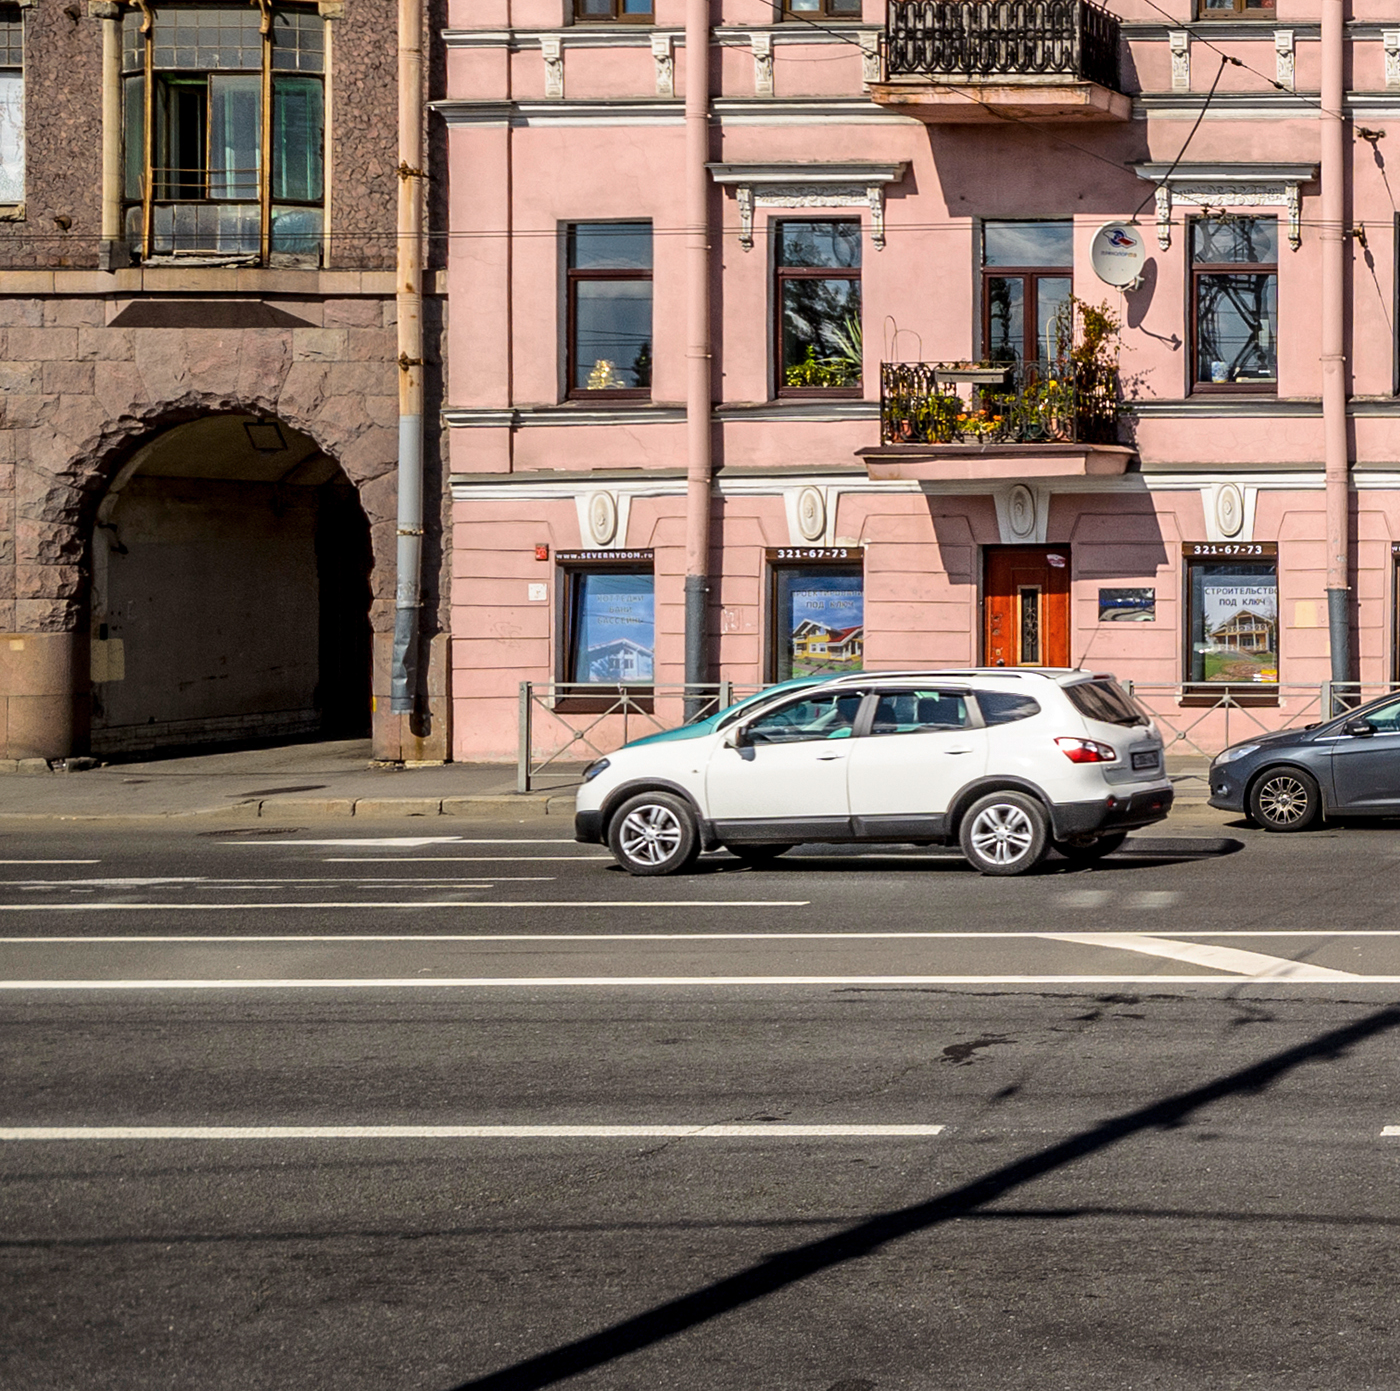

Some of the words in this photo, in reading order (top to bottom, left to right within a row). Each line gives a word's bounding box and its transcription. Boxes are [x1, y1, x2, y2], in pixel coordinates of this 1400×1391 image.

[777, 549, 848, 559] 321-67-73
[1194, 545, 1262, 555] 321-67-73
[555, 552, 653, 560] www.SEVERNYDOM.ru
[806, 601, 825, 609] ПОД
[1219, 598, 1237, 606] ПОД
[1242, 598, 1266, 606] КЛЮЧ
